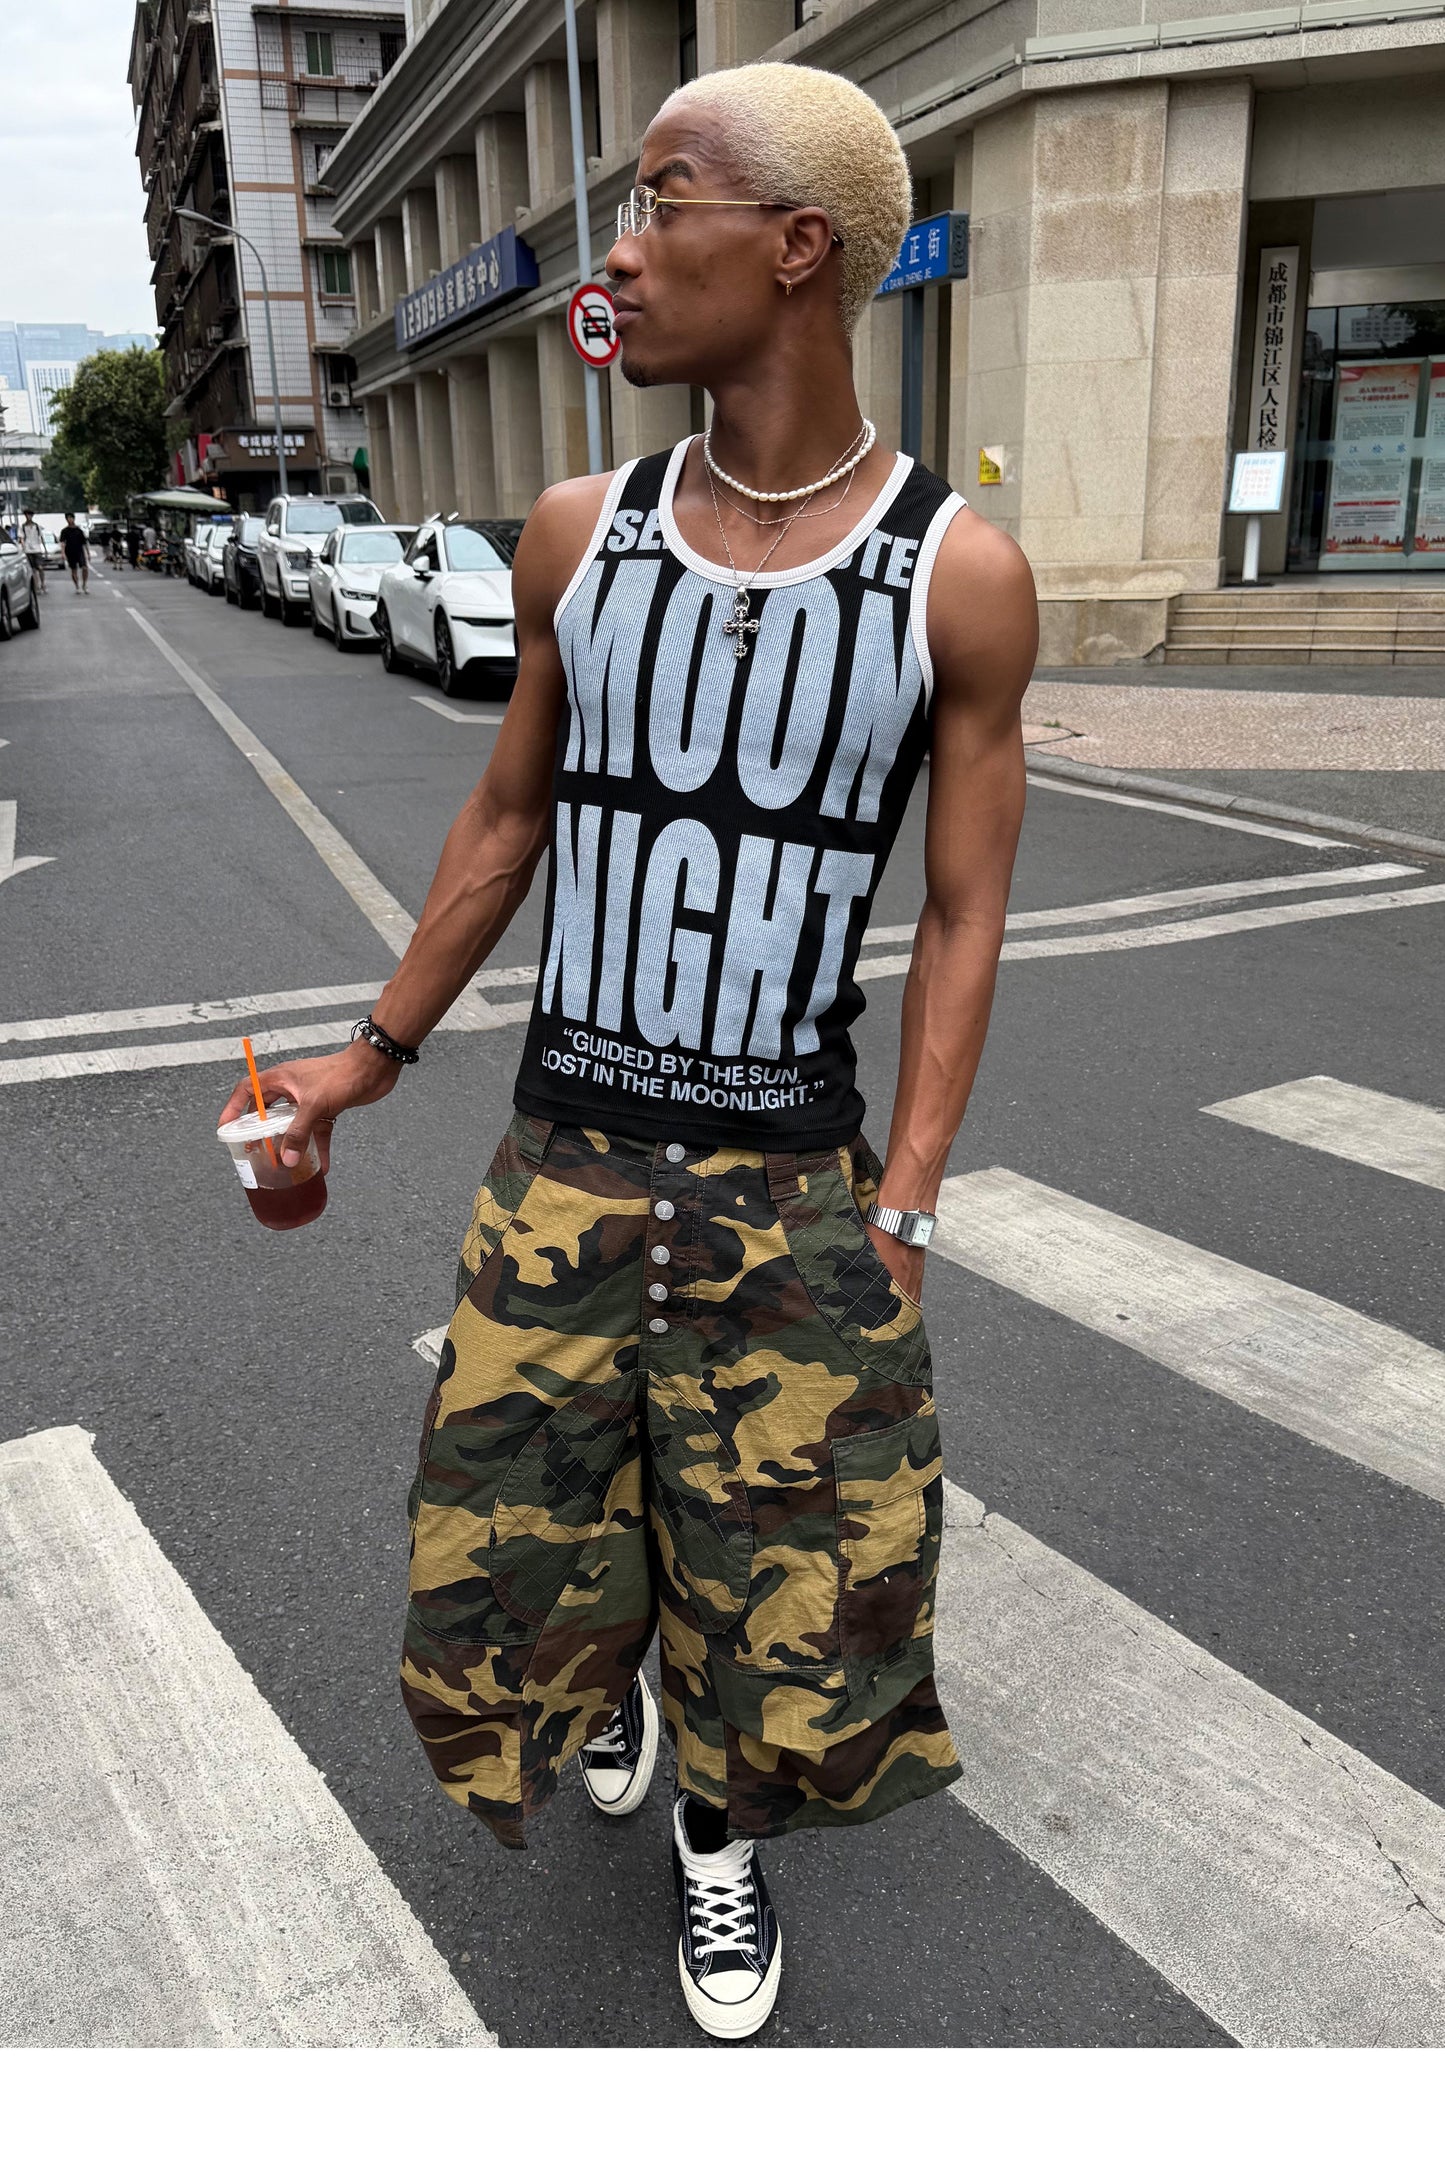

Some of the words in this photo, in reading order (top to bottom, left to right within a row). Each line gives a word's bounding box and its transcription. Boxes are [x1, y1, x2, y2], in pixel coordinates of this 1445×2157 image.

[1256, 262, 1289, 451] 成都市锦江区人民检
[833, 528, 919, 589] TE
[556, 558, 923, 823] MOON
[541, 801, 876, 1061] NIGHT
[541, 1046, 591, 1078] LOST
[592, 1062, 614, 1087] IN
[619, 1069, 665, 1099] THE
[670, 1080, 825, 1111] MOONLIGHT.”
[563, 1027, 654, 1070] “GUIDED
[660, 1053, 694, 1076] BY
[699, 1060, 746, 1086] THE
